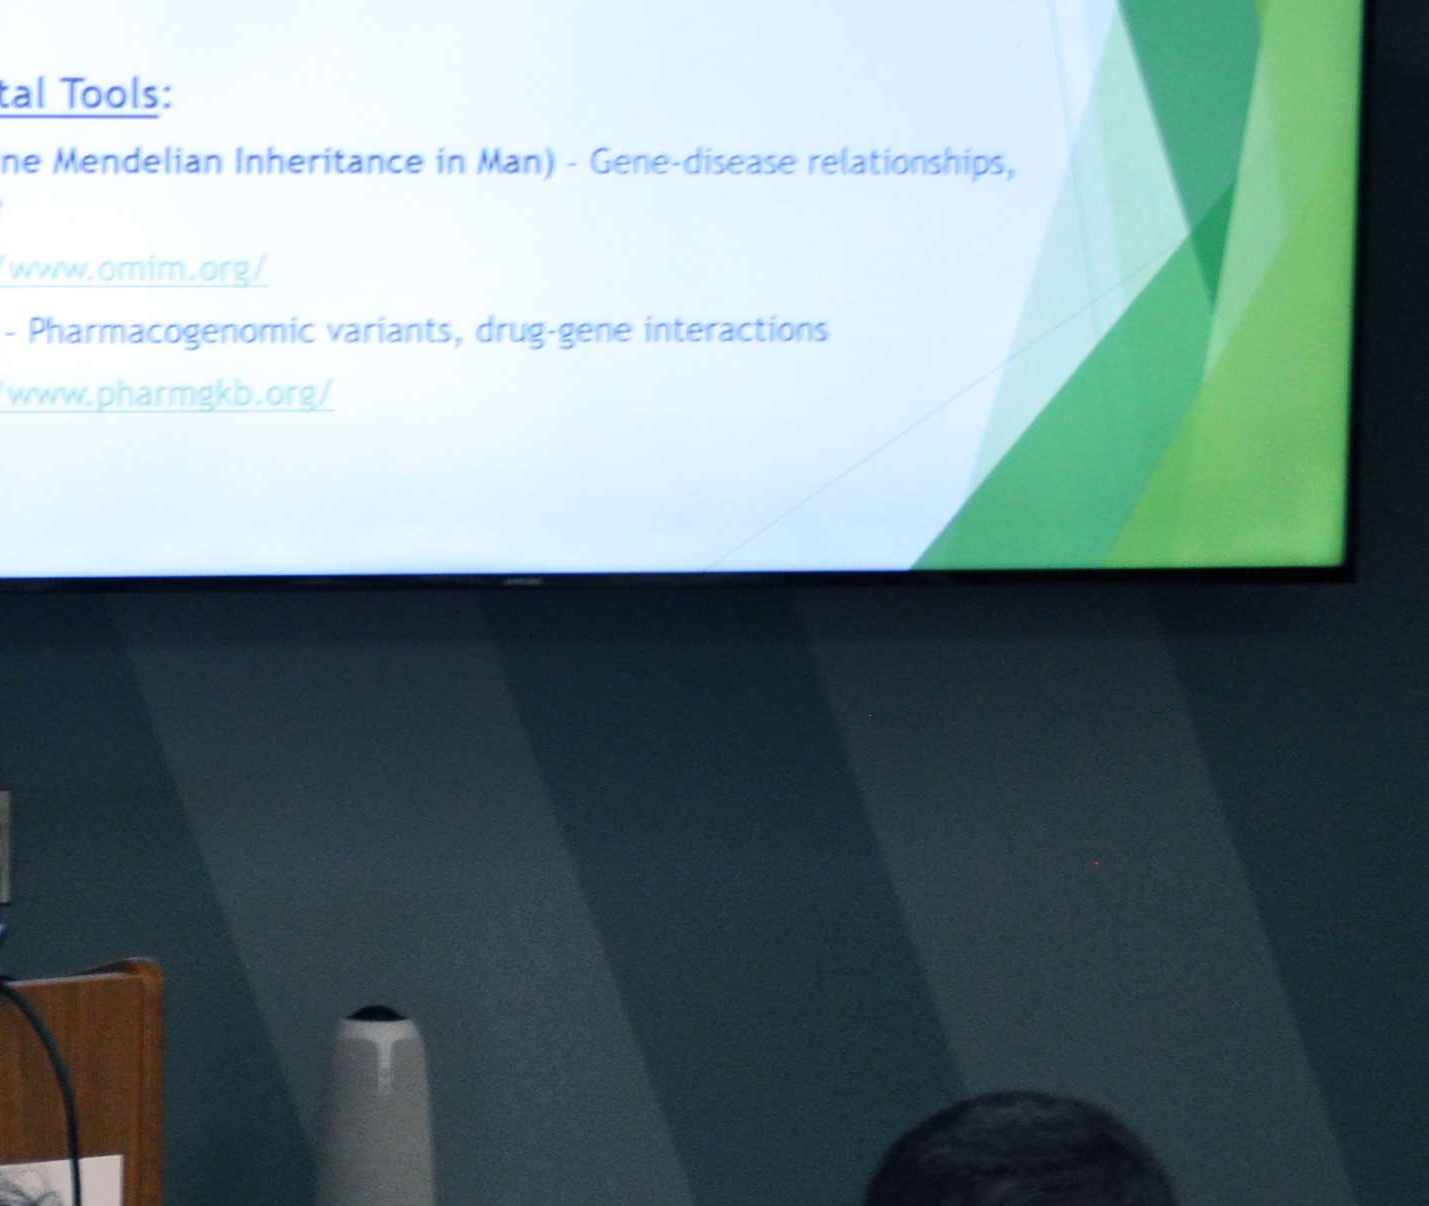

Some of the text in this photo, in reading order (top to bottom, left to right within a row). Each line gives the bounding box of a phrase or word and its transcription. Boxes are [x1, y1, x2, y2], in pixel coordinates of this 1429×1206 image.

[58, 75, 173, 109] Tools:
[52, 145, 224, 175] Mendelian
[235, 144, 426, 175] Inheritance
[435, 147, 468, 175] in
[477, 147, 557, 180] Man)
[590, 146, 798, 176] Gene-disease
[808, 146, 1016, 182] relationships,
[29, 315, 316, 352] Pharmacogenomic
[326, 316, 464, 348] variants,
[475, 315, 635, 350] drug-gene
[644, 315, 831, 343] interactions
